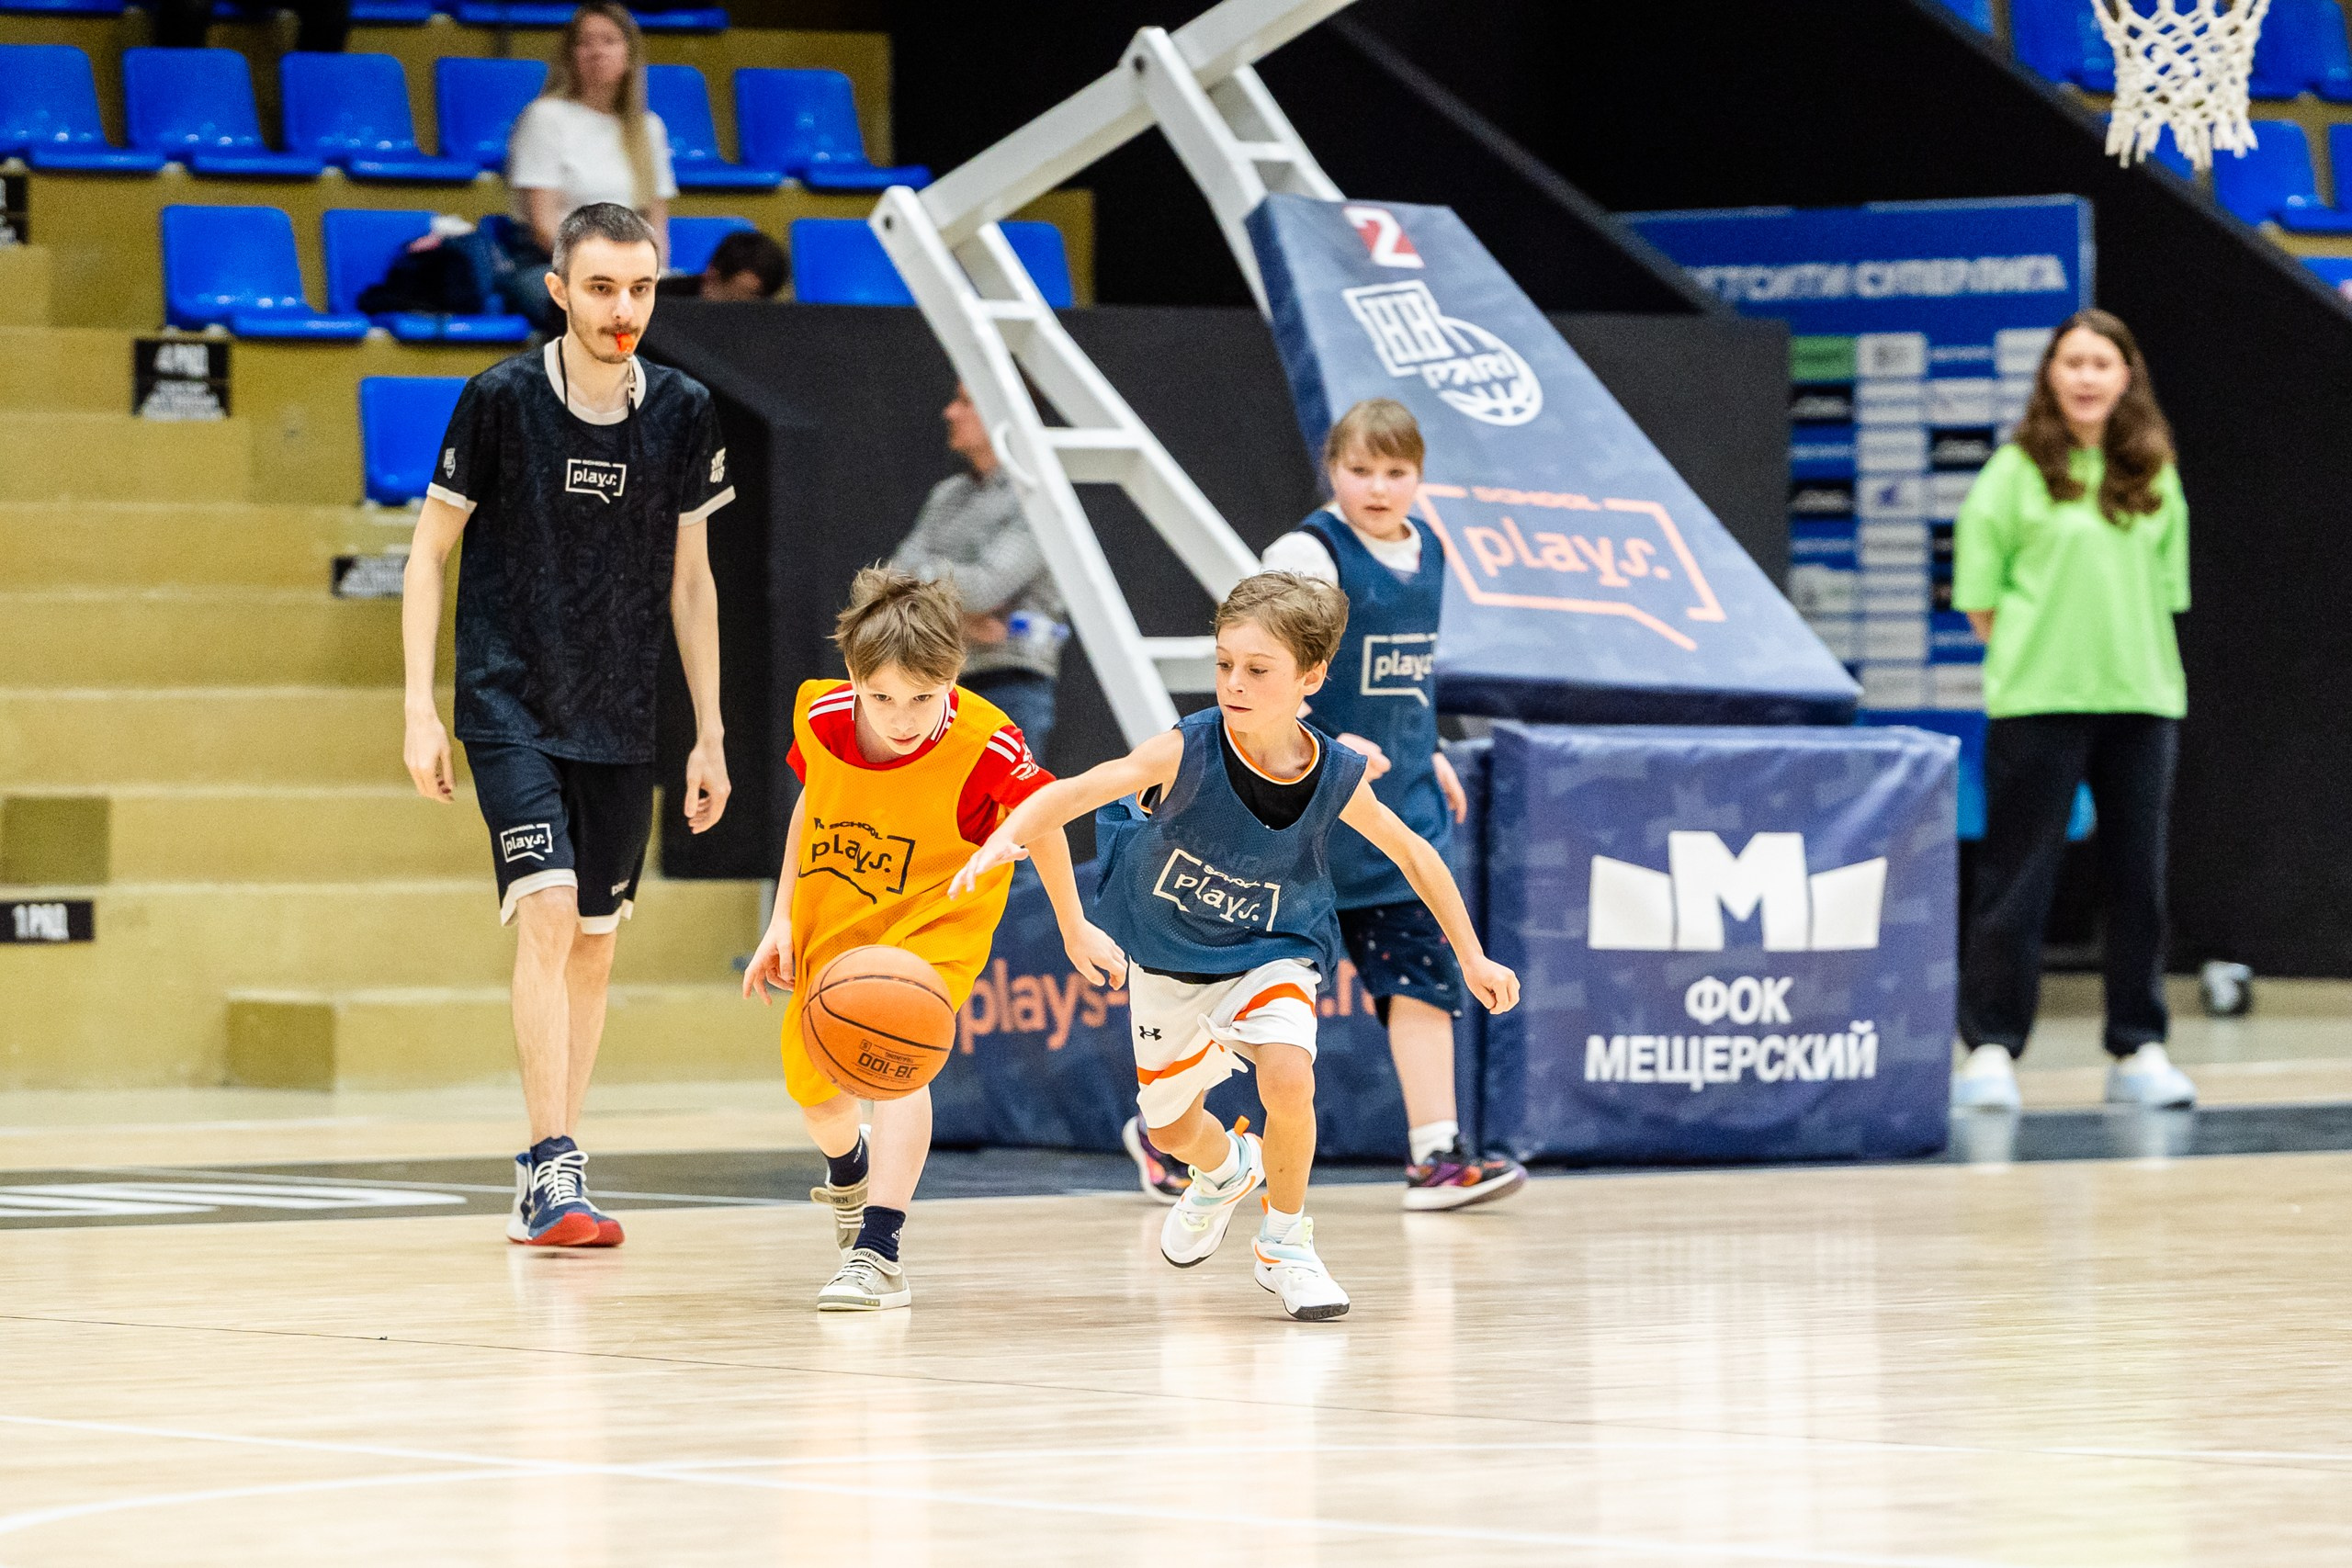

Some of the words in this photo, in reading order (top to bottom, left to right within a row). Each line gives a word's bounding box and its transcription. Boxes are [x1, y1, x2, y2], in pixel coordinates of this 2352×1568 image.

[1344, 205, 1425, 268] 2
[1464, 516, 1670, 587] plays.
[812, 834, 892, 874] plays.
[1174, 874, 1261, 923] plays.
[1685, 976, 1794, 1025] ФОК
[1584, 1020, 1879, 1093] МЕЩЕРСКИЙ
